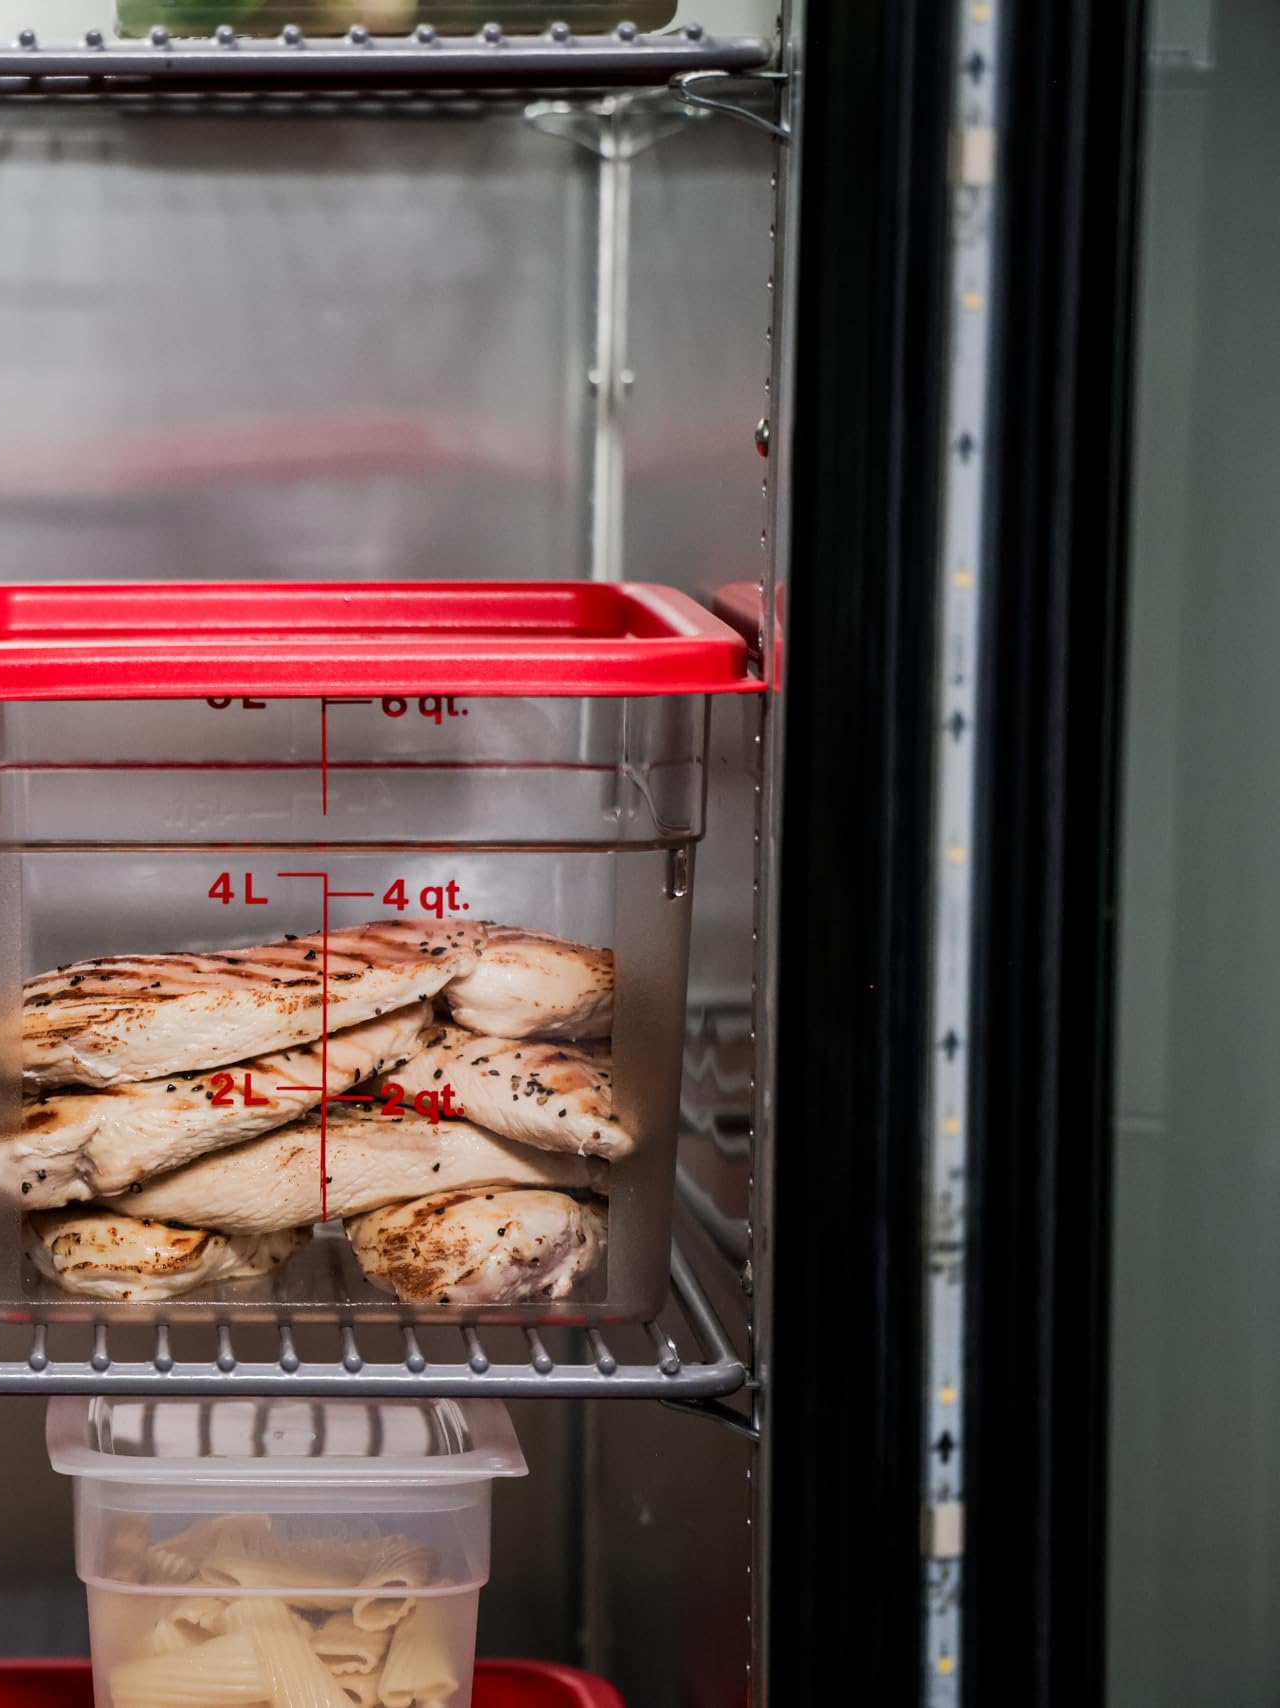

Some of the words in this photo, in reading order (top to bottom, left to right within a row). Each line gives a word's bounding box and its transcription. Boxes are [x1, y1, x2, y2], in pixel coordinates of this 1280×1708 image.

[418, 698, 470, 726] qt.
[208, 872, 235, 905] 4
[244, 872, 269, 905] L
[382, 879, 409, 911] 4
[419, 879, 470, 919] qt.
[210, 1073, 234, 1106] 2
[244, 1073, 270, 1107] L
[380, 1083, 406, 1117] 2
[414, 1083, 466, 1125] qt.
